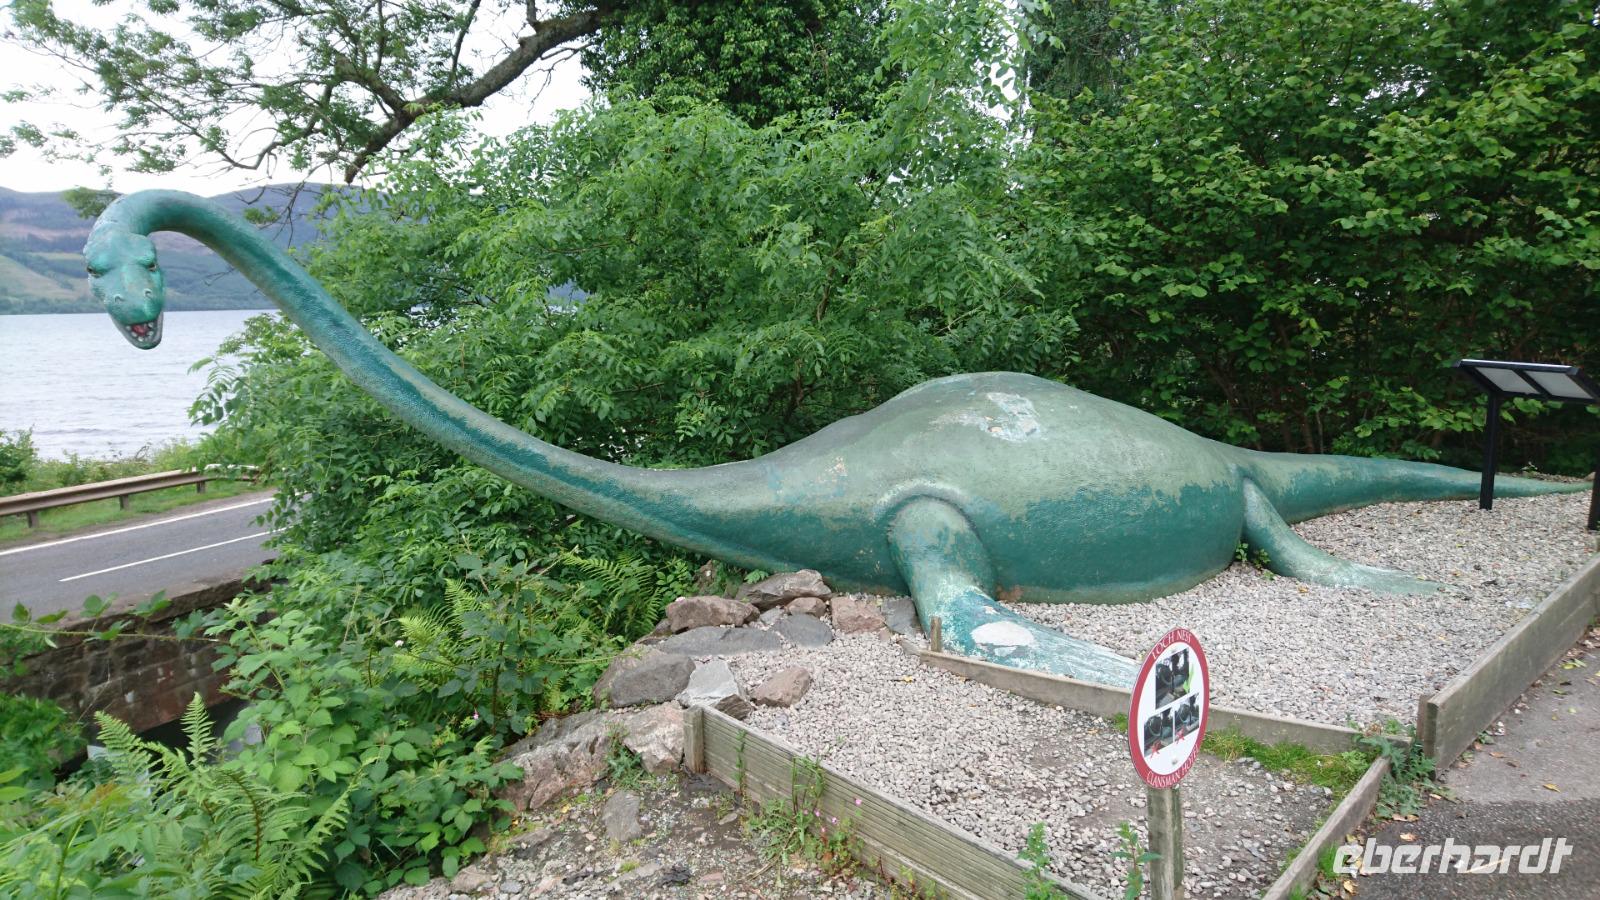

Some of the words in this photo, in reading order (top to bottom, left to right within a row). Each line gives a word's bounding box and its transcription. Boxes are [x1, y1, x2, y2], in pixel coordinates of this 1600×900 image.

[1151, 631, 1175, 660] LOCH
[1176, 629, 1192, 643] NESS
[1146, 770, 1181, 788] CLANSMAN
[1181, 744, 1200, 776] HOTEL
